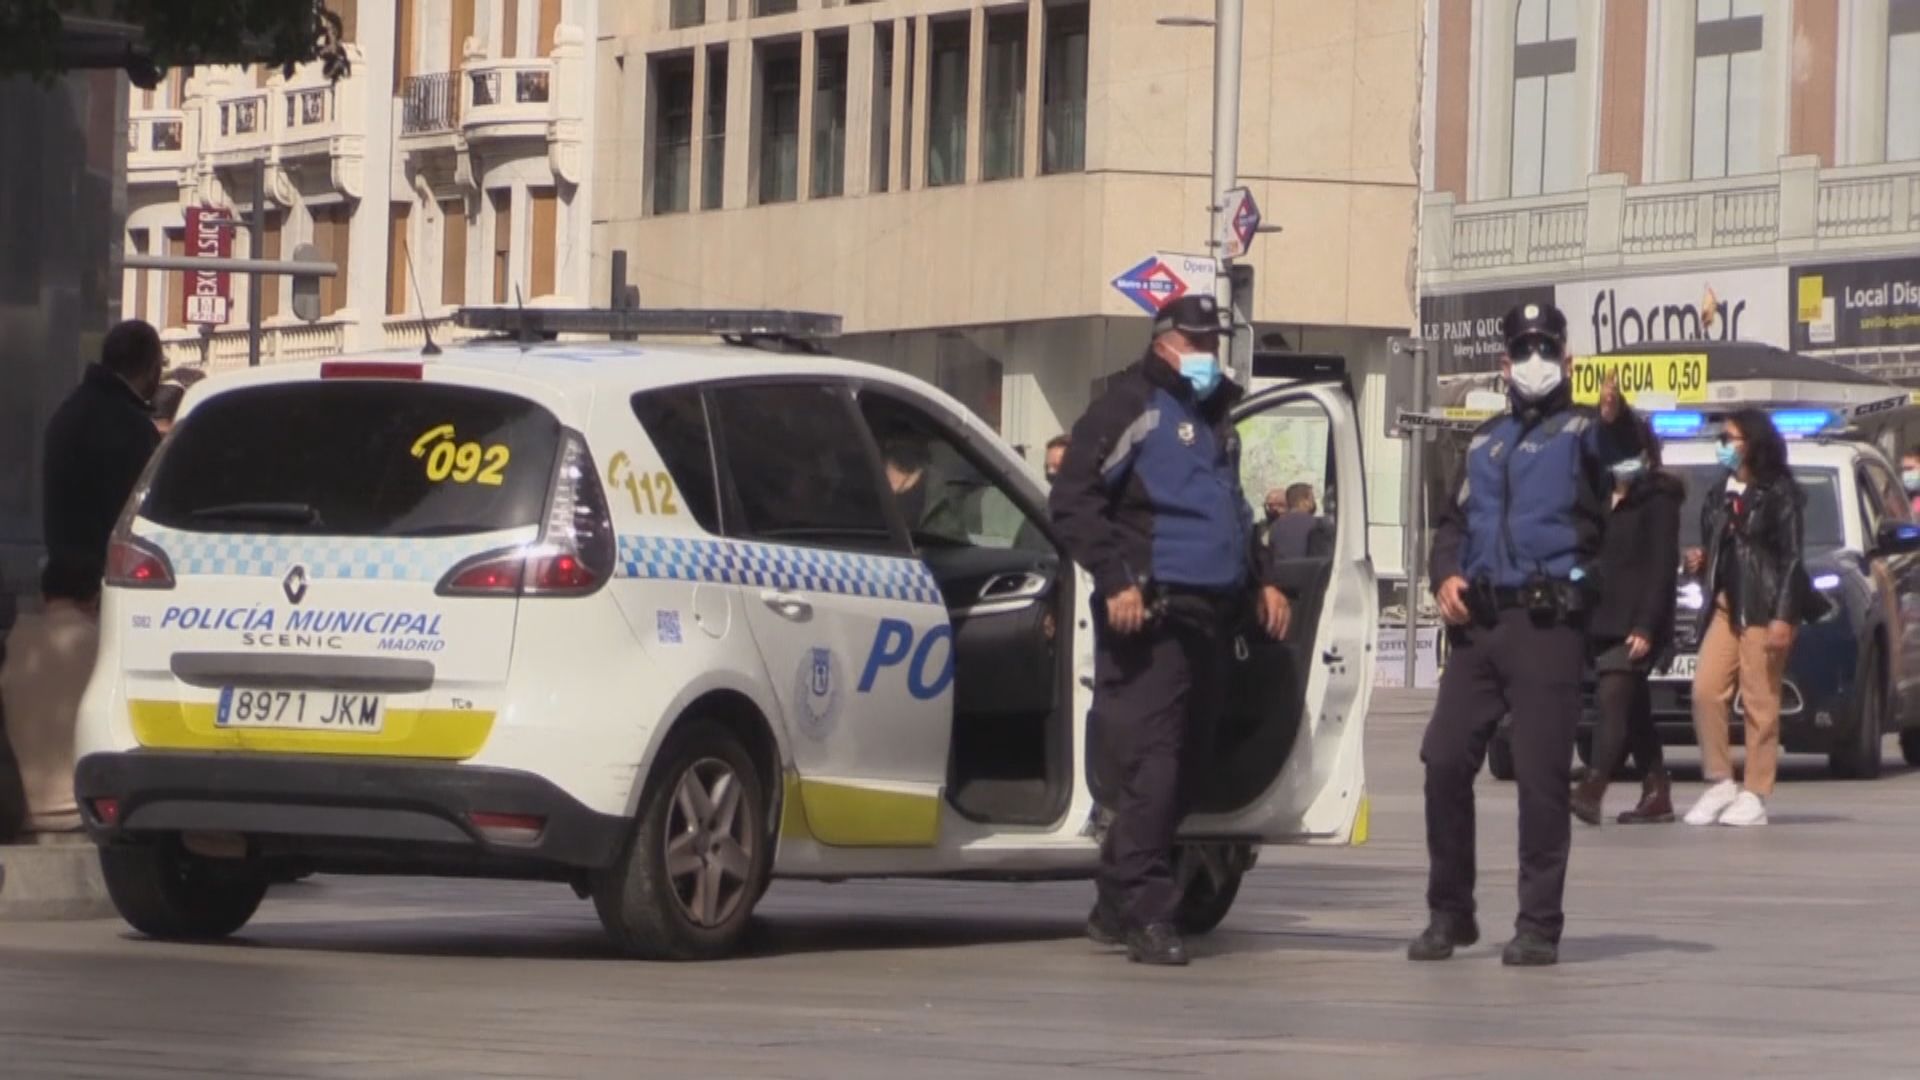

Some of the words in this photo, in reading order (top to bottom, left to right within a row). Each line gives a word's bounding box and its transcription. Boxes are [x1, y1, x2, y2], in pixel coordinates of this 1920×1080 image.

[1845, 283, 1888, 308] Local
[1443, 320, 1472, 340] PAIN
[1668, 360, 1701, 395] 0,50
[426, 440, 511, 486] 092
[625, 471, 678, 515] 112
[285, 609, 442, 636] MUNICIPAL
[242, 633, 343, 650] SCENIC
[377, 637, 446, 652] MADRID
[236, 691, 307, 722] 8971
[320, 694, 379, 726] JKM
